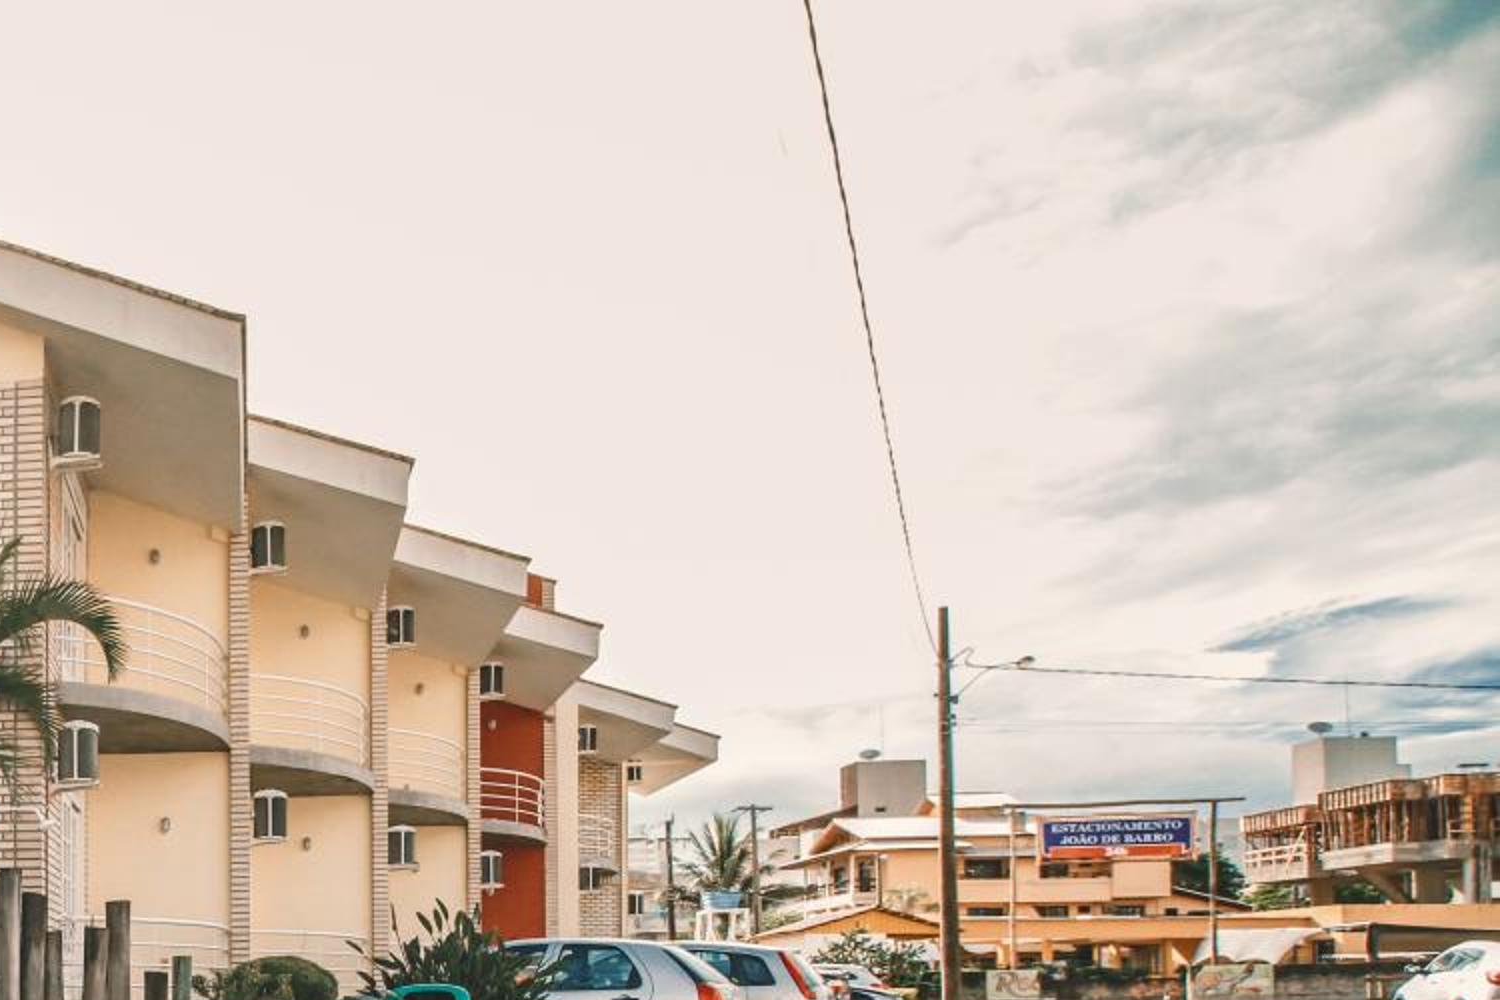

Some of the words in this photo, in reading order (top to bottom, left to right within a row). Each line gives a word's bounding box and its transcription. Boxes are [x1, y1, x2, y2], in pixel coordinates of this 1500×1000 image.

[1051, 820, 1182, 834] ESTACIONAMENTO
[1060, 832, 1098, 845] JOÃO
[1101, 833, 1121, 844] DE
[1123, 832, 1173, 844] BARRO
